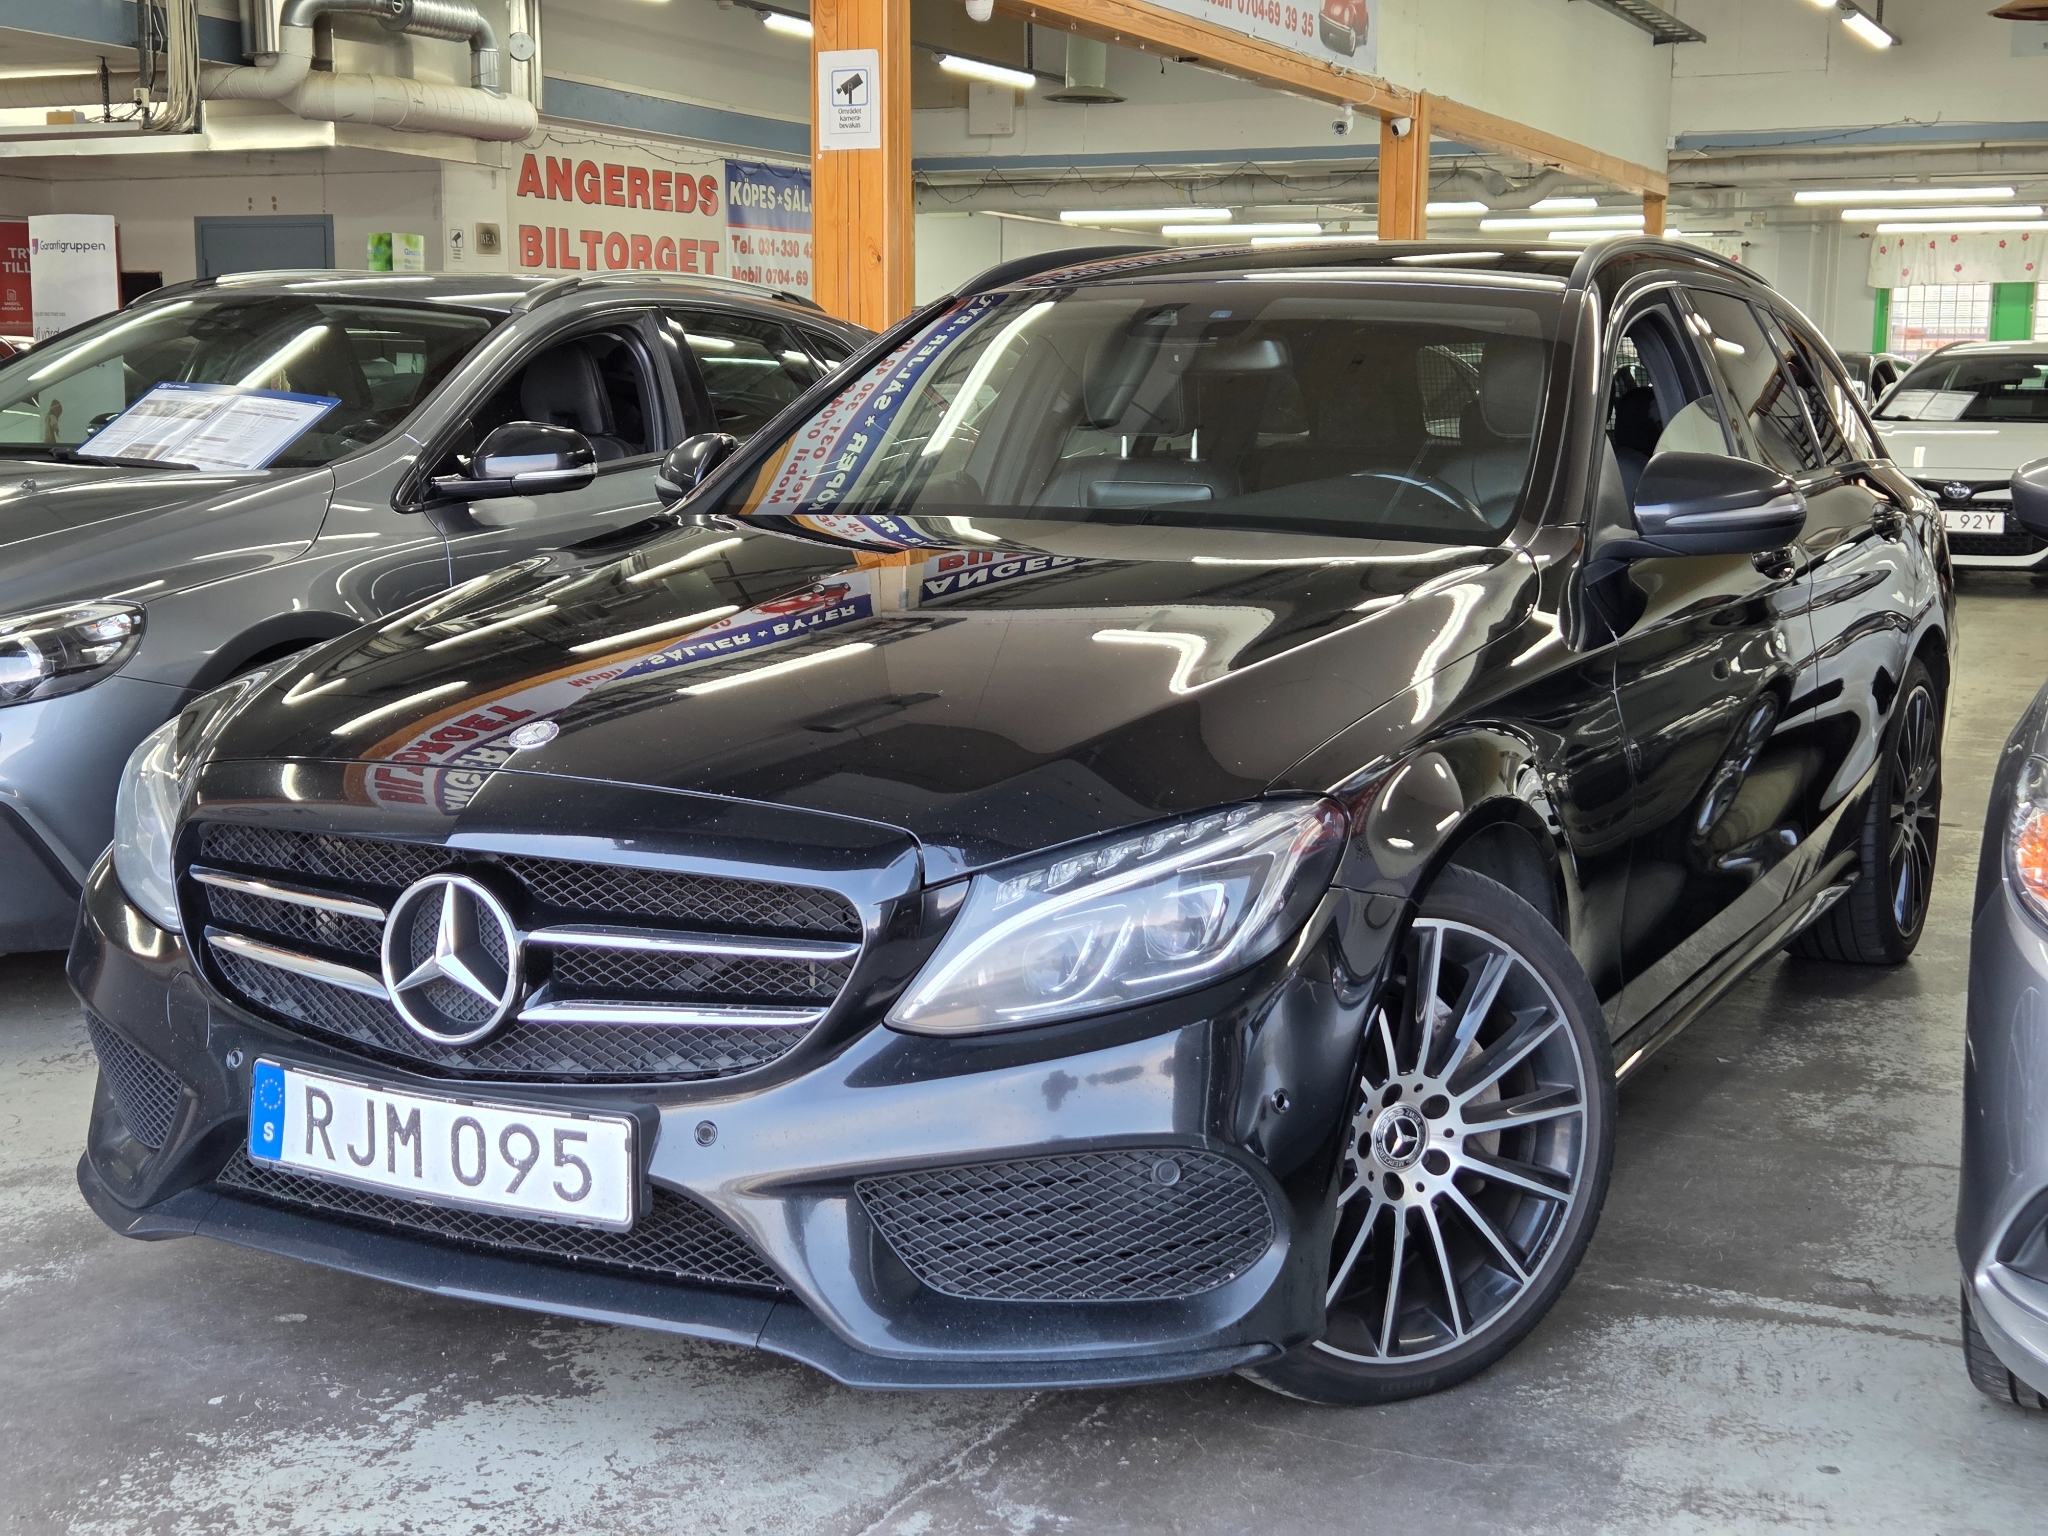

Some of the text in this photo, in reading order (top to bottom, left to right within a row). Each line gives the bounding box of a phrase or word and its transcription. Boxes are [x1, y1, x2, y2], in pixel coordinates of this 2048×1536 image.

[1285, 5, 1298, 32] 39
[1301, 11, 1314, 38] 35
[516, 152, 719, 217] ANGEREDS
[783, 184, 812, 213] SÄL
[40, 239, 106, 253] Garantigruppen
[518, 224, 720, 276] BILTORGET
[731, 234, 755, 255] Tel.
[731, 265, 808, 286] Mobil 0704-69
[1960, 513, 1996, 530] 92Y
[262, 1121, 275, 1142] S
[305, 1084, 593, 1203] RJM 095
